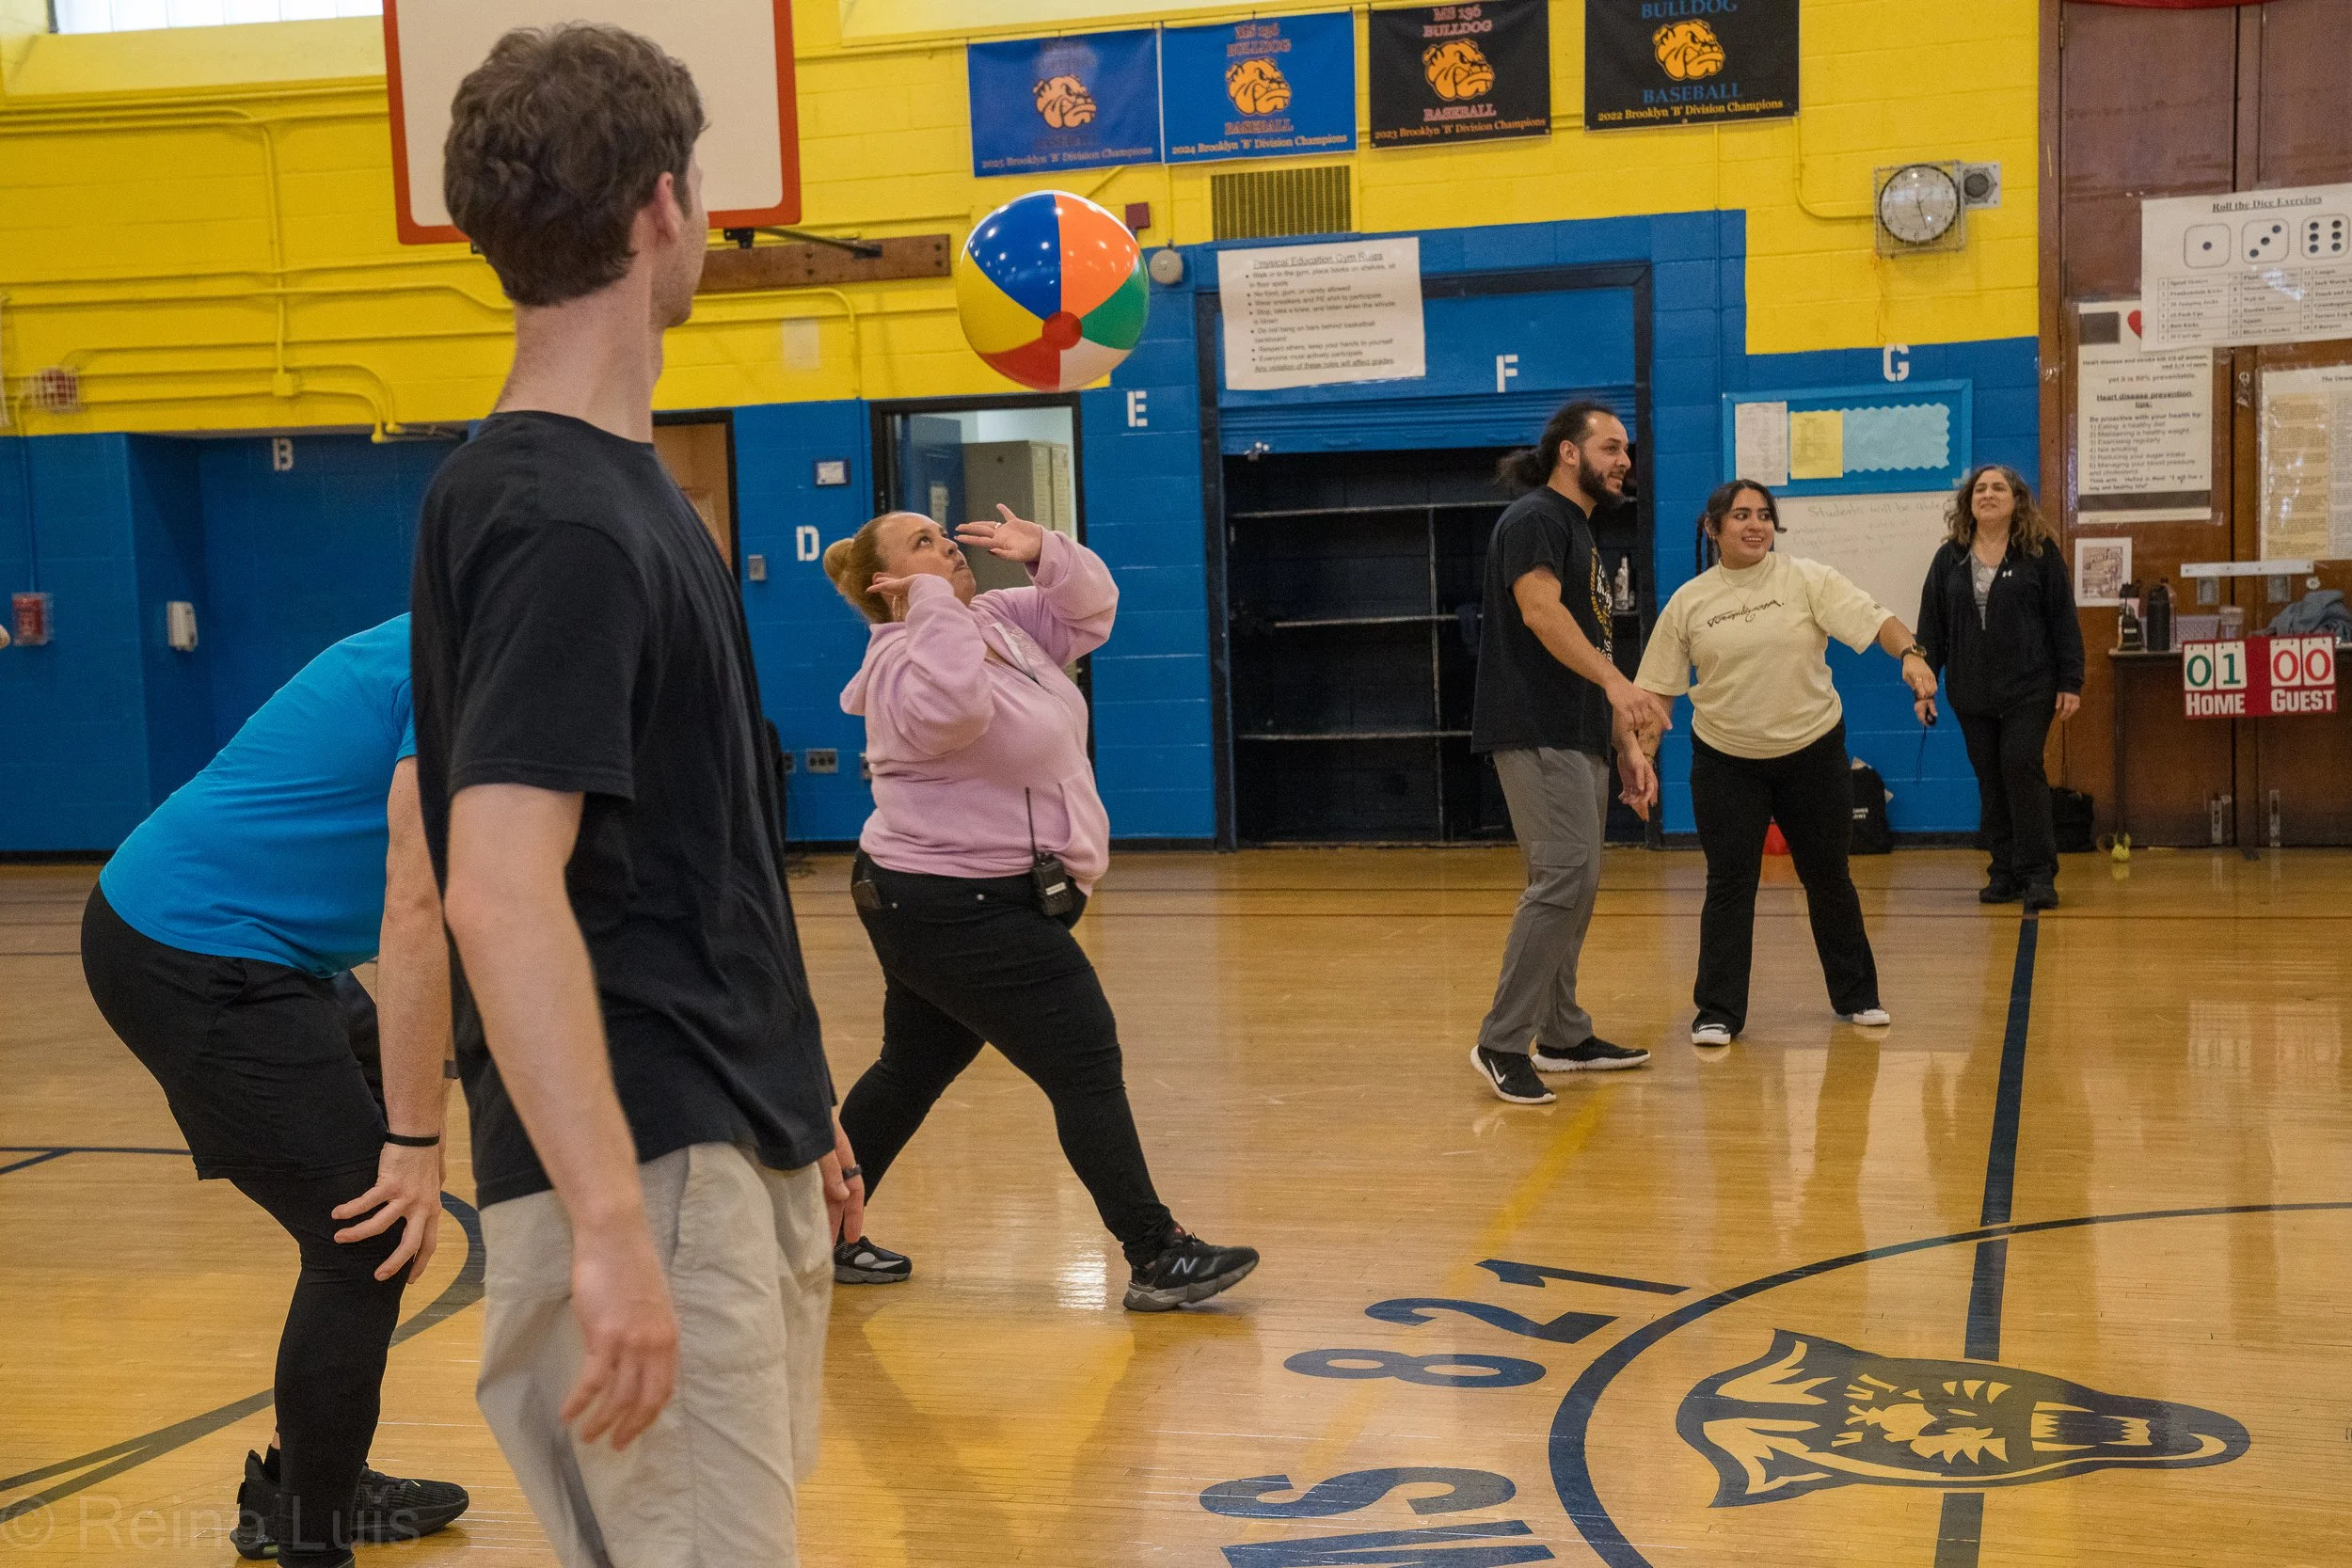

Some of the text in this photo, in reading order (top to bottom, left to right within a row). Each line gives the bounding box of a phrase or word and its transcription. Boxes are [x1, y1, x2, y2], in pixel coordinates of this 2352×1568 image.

[1641, 0, 1739, 19] BULLDOG
[1423, 20, 1492, 38] BULLDOG
[1643, 81, 1740, 105] BASEBALL
[1423, 103, 1496, 121] BASEBALL
[1597, 111, 1622, 122] 2022
[1625, 106, 1668, 121] Brooklyn
[1685, 102, 1725, 116] Division
[1727, 97, 1783, 113] Champions
[1375, 130, 1398, 140] 2023
[1400, 125, 1439, 139] Brooklyn
[1455, 120, 1492, 133] Division
[1495, 117, 1546, 132] Champions
[1199, 140, 1238, 154] Brooklyn
[1255, 135, 1293, 149] Division
[1295, 131, 1347, 148] Champions
[1007, 154, 1046, 166] Brooklyn
[2213, 202, 2233, 213] Roll
[2235, 201, 2249, 210] the
[2253, 199, 2273, 209] Dice
[1497, 355, 1518, 392] F
[1883, 345, 1910, 381] G
[1127, 390, 1148, 427] E
[272, 437, 294, 470] B
[796, 526, 820, 562] D
